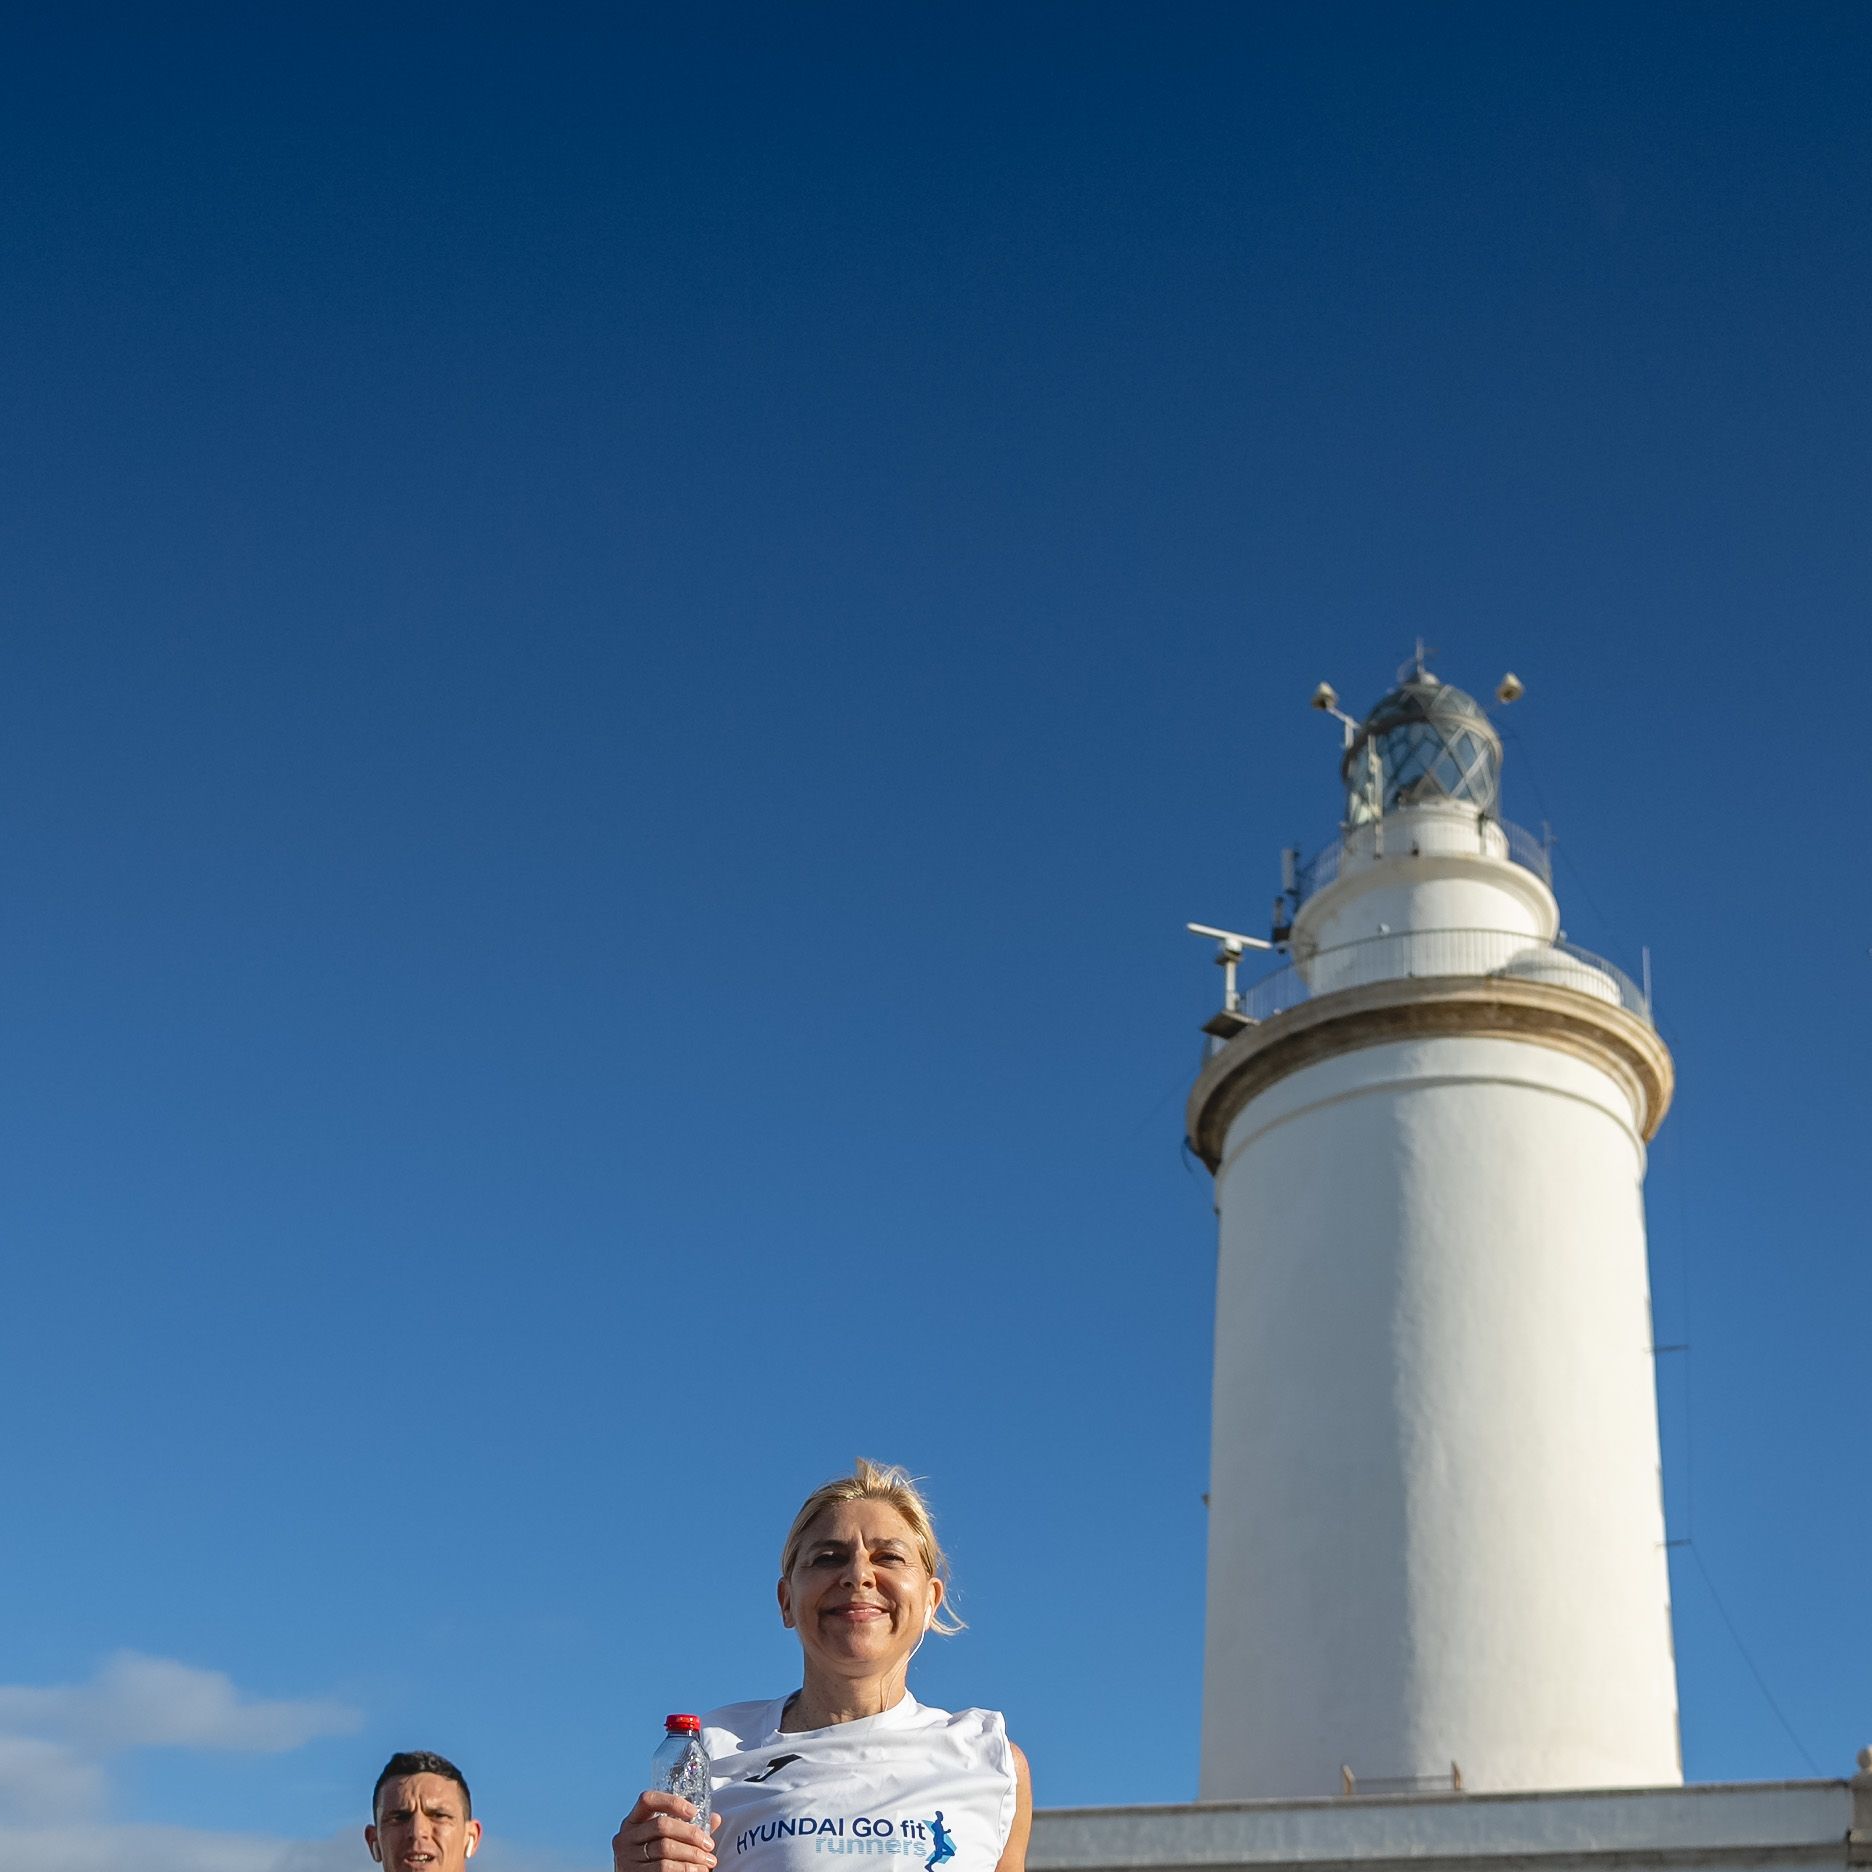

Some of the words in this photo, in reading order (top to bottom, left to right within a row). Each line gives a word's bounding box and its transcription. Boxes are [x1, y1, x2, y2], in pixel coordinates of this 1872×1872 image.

[736, 1817, 844, 1854] HYUNDAI
[852, 1817, 894, 1837] GO
[899, 1819, 927, 1841] fit
[815, 1836, 927, 1857] runners
